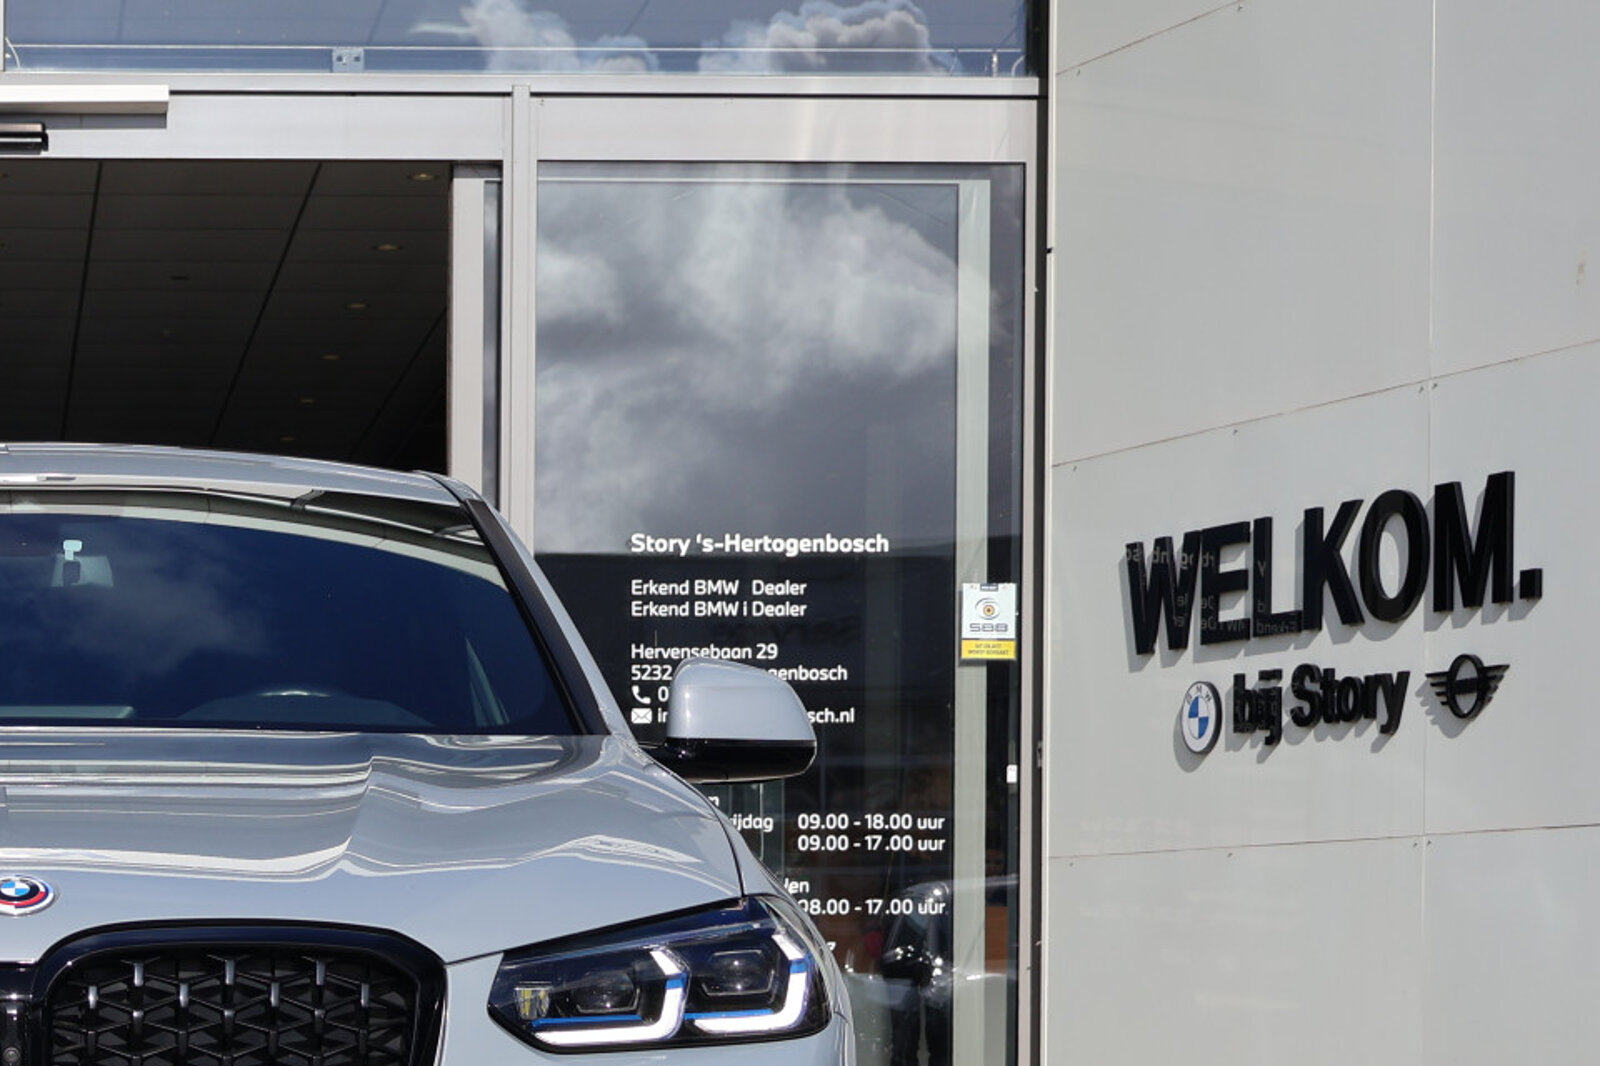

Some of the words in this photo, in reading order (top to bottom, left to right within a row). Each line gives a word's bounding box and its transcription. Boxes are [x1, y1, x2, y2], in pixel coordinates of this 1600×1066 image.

[630, 533, 691, 557] Story
[1126, 471, 1543, 655] WELKOM.
[631, 579, 690, 596] Erkend
[694, 579, 740, 596] BMW
[751, 579, 808, 596] Dealer
[631, 601, 690, 617] Erkend
[694, 601, 740, 617] BMW
[742, 600, 748, 617] i
[751, 601, 808, 617] Dealer
[631, 643, 753, 660] Hervensebaan
[756, 643, 778, 660] 29
[631, 665, 673, 681] 5232
[1234, 669, 1283, 746] bij
[1290, 663, 1410, 736] Story
[797, 813, 849, 830] 09.00
[864, 813, 913, 830] 18.00
[917, 817, 946, 830] uur
[797, 835, 849, 851] 09.00
[917, 839, 946, 851] uur
[917, 902, 946, 915] uur
